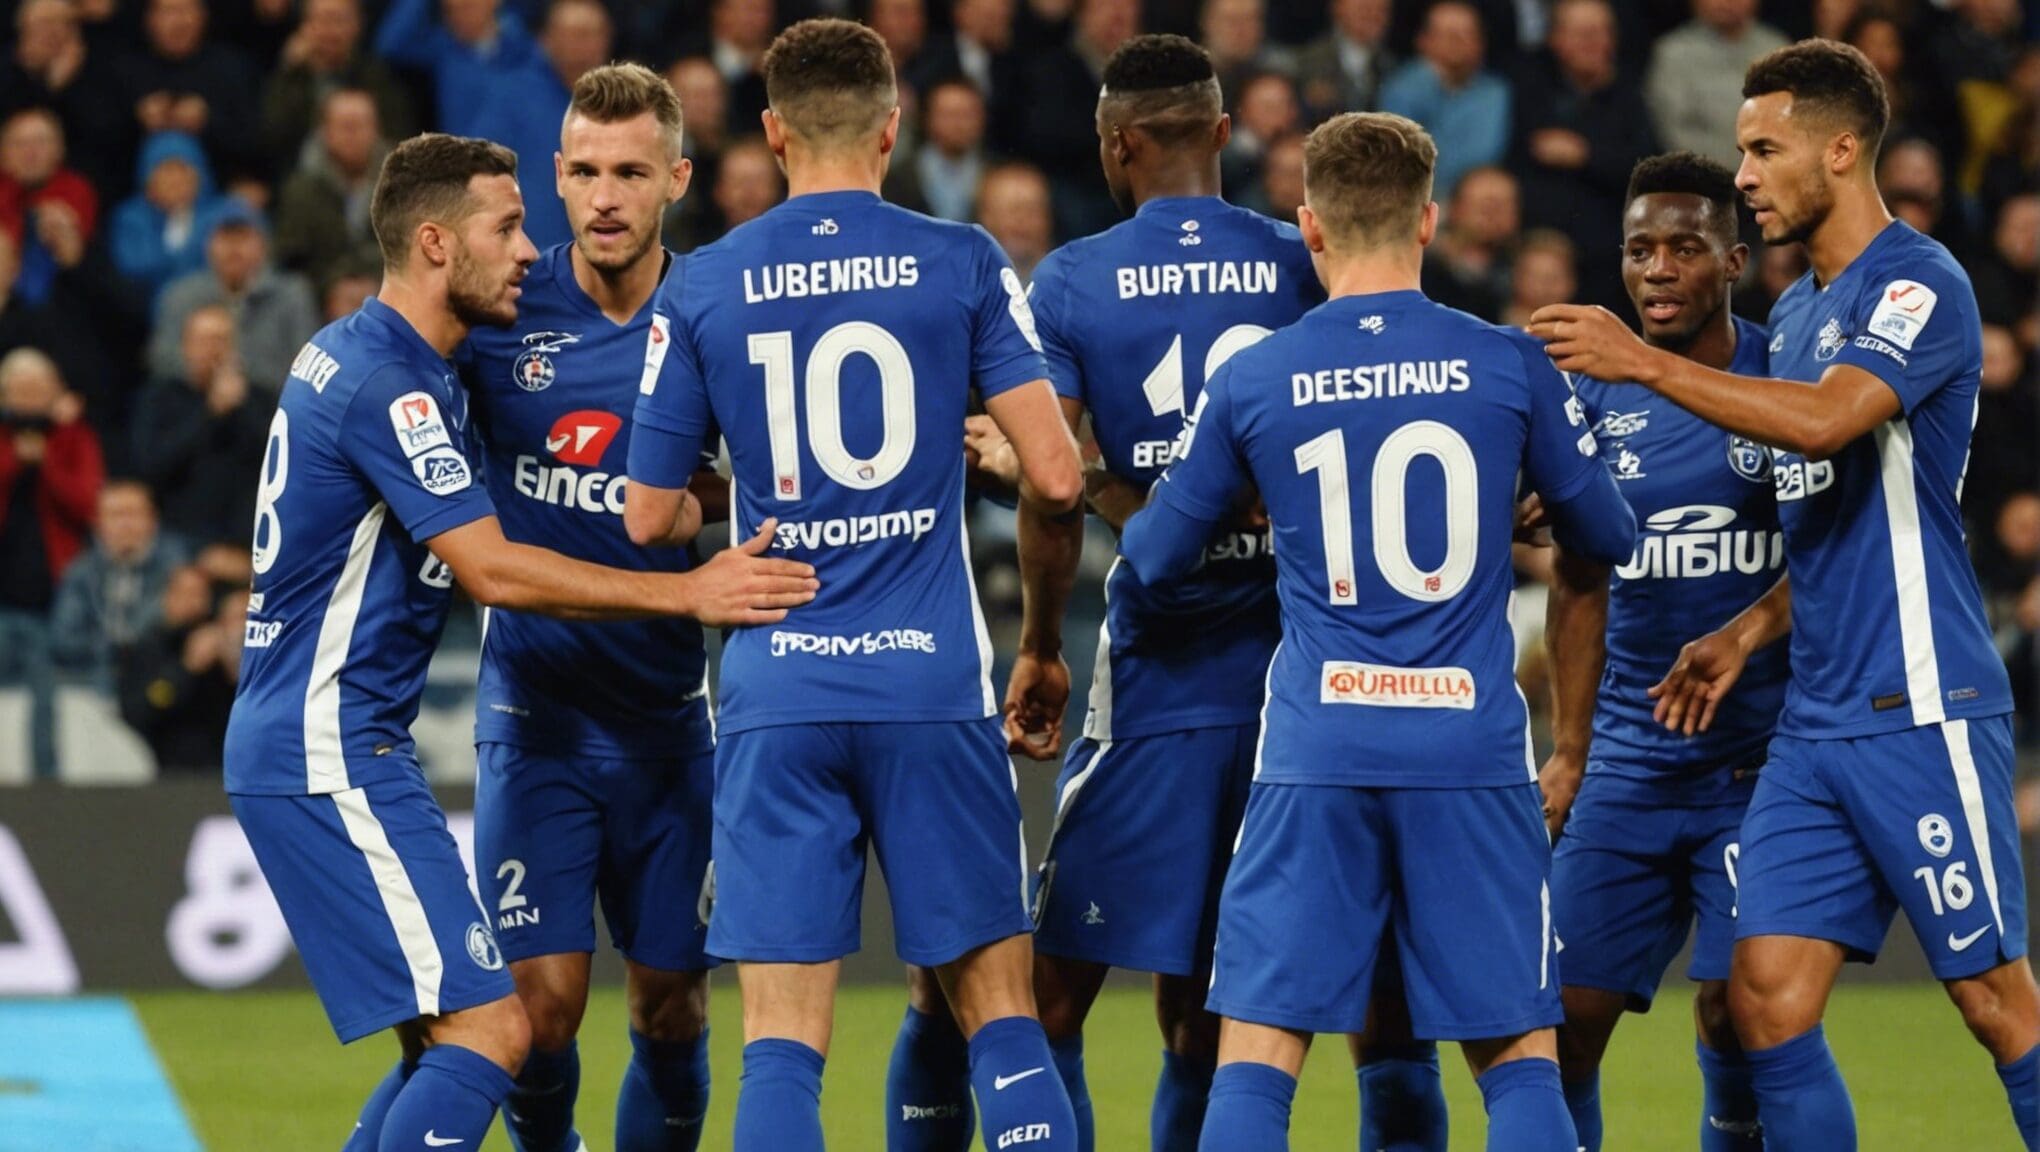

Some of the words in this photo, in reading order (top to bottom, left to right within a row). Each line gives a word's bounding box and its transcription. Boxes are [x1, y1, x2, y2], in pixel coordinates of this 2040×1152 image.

[747, 321, 917, 501] 10
[1294, 419, 1479, 606] 10
[496, 858, 527, 911] 2
[1913, 860, 1974, 916] 16
